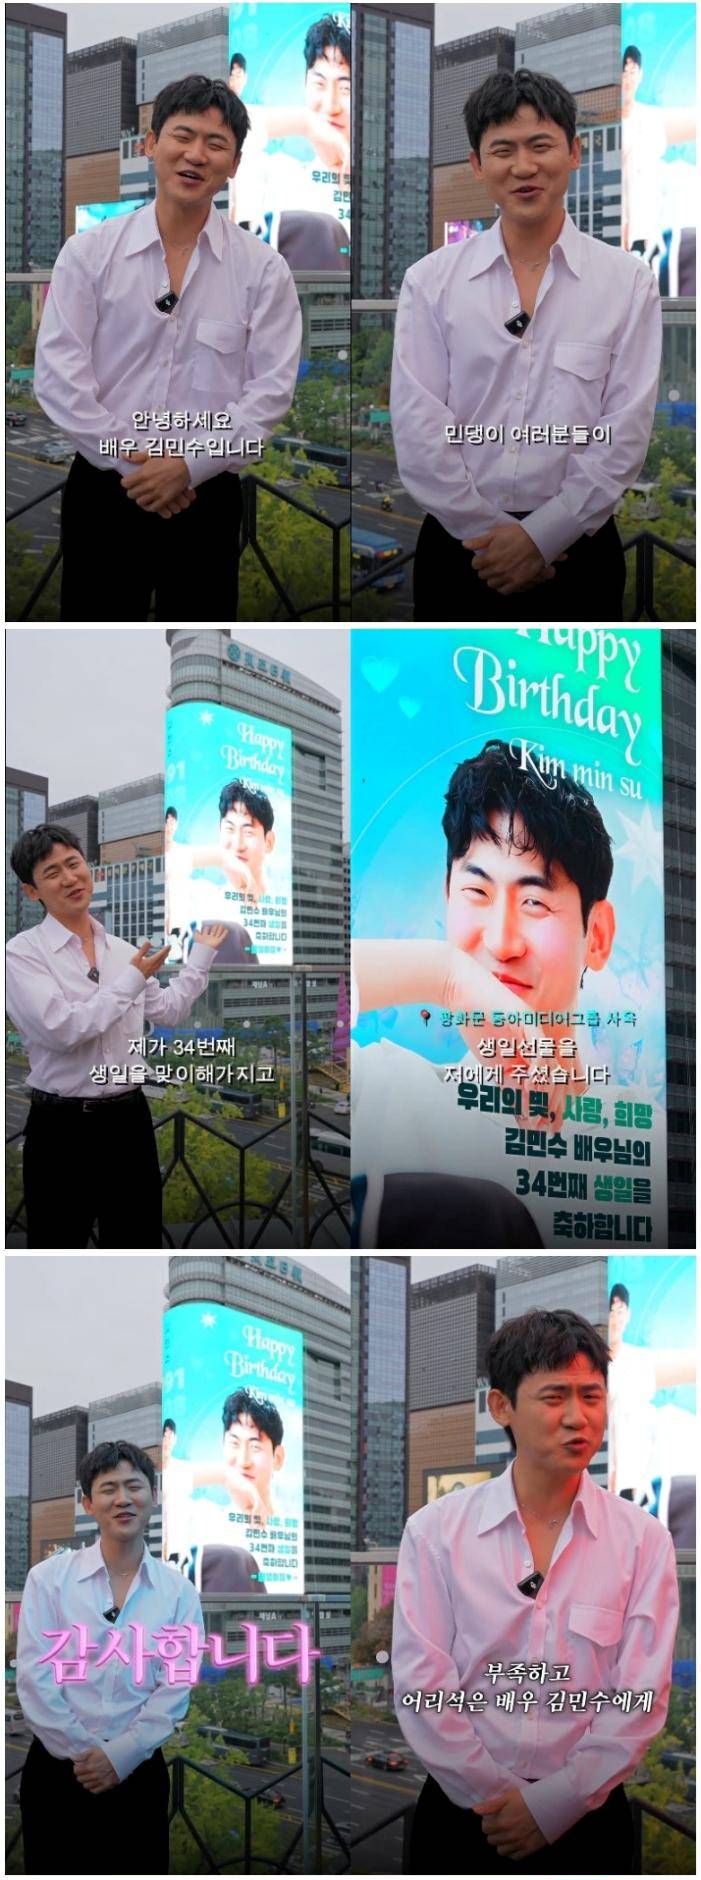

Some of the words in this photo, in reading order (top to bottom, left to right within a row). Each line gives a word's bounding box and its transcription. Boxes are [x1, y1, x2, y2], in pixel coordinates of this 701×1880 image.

[453, 646, 642, 767] Birthday
[237, 722, 284, 759] Happy
[220, 744, 285, 784] Birthday
[509, 737, 567, 790] Kim
[573, 760, 614, 793] min
[619, 776, 643, 800] su
[457, 1082, 522, 1116] 우리의
[562, 1094, 608, 1128] 사랑,
[614, 1100, 653, 1130] 희망
[505, 1127, 568, 1158] 김민수
[574, 1134, 652, 1167] 배우님의
[516, 1168, 588, 1201] 34번째
[594, 1175, 652, 1204] 생일을
[553, 1210, 653, 1243] 축하합니다
[242, 1324, 296, 1367] Happy
[223, 1350, 296, 1395] Birthday
